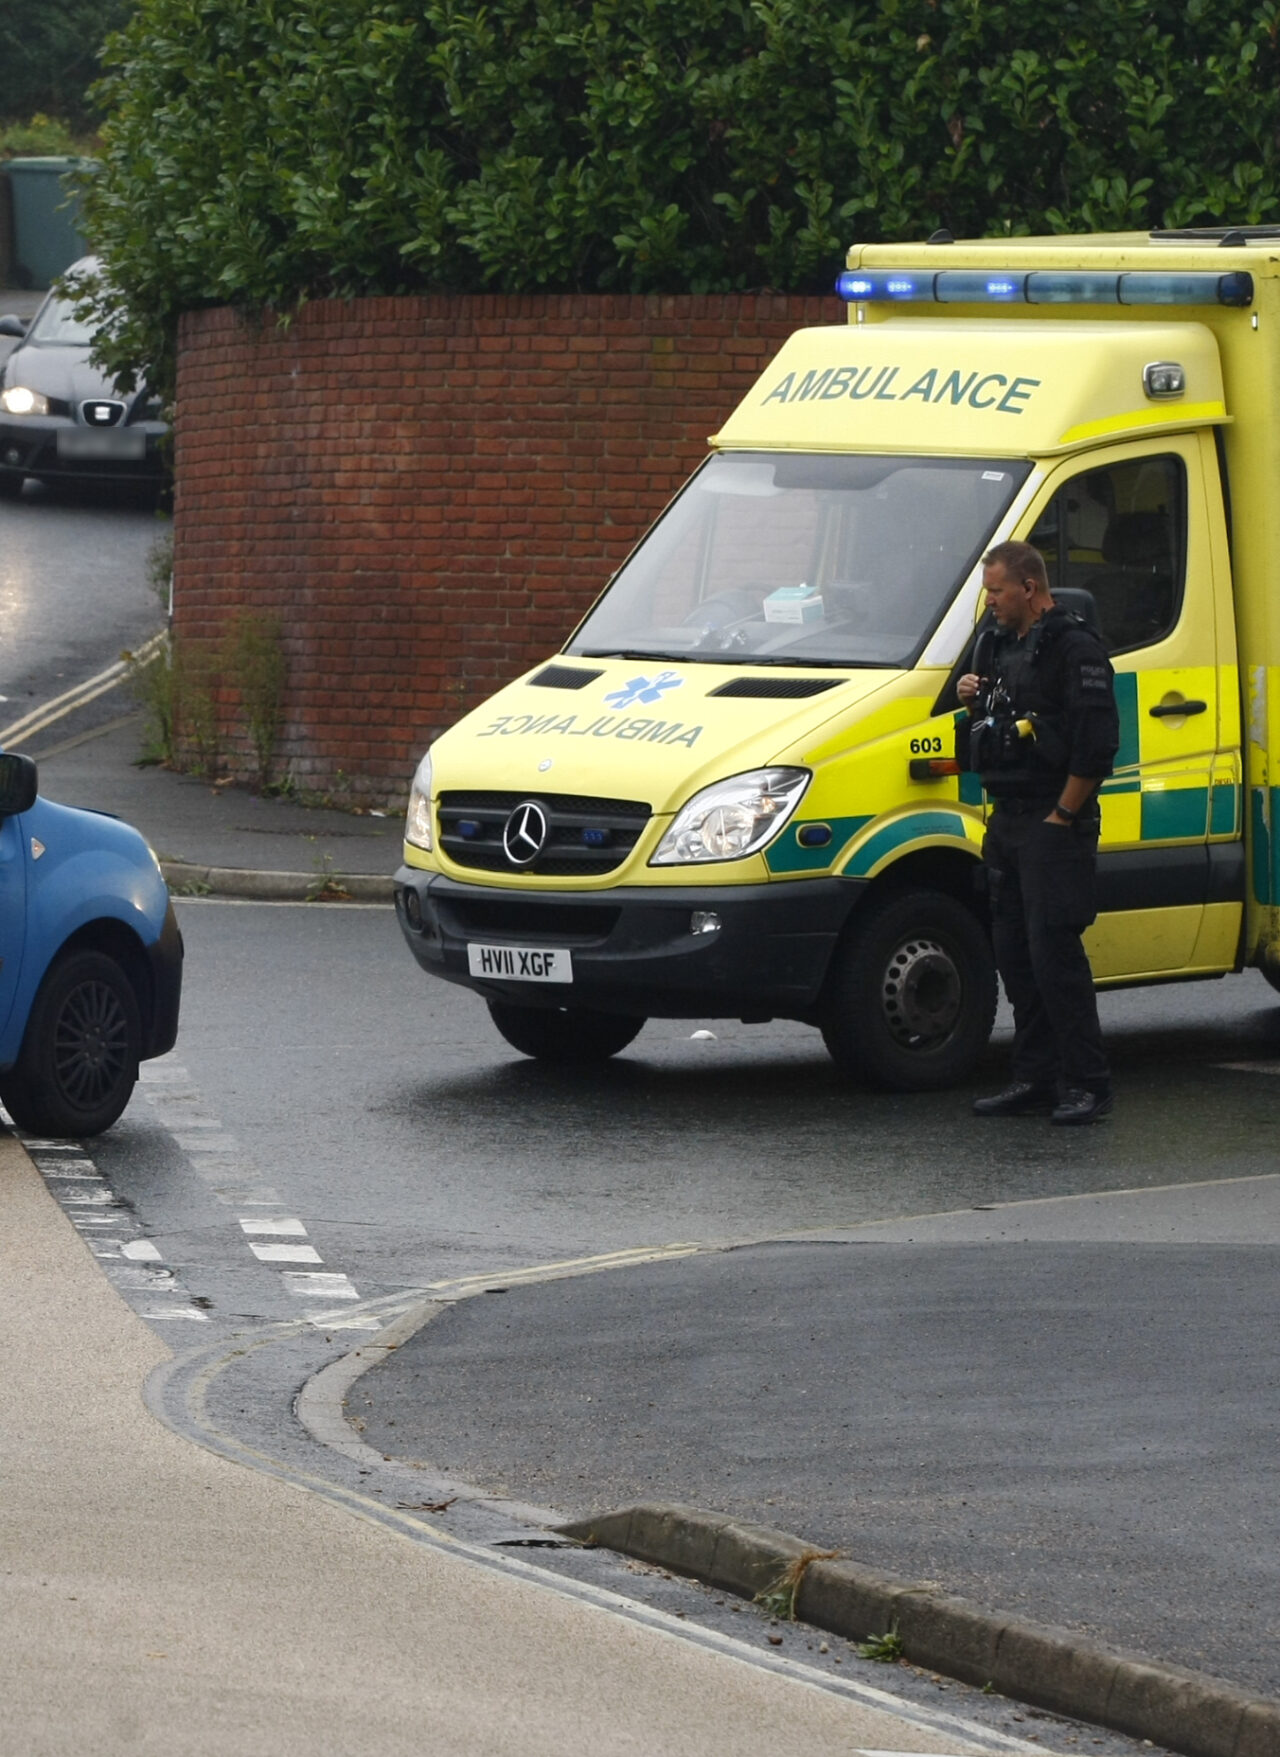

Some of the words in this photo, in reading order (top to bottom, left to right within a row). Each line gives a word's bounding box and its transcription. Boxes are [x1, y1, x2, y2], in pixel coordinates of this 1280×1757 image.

[760, 366, 1042, 415] AMBULANCE
[910, 737, 942, 754] 603
[481, 948, 515, 975] HV11
[518, 951, 555, 977] XGF
